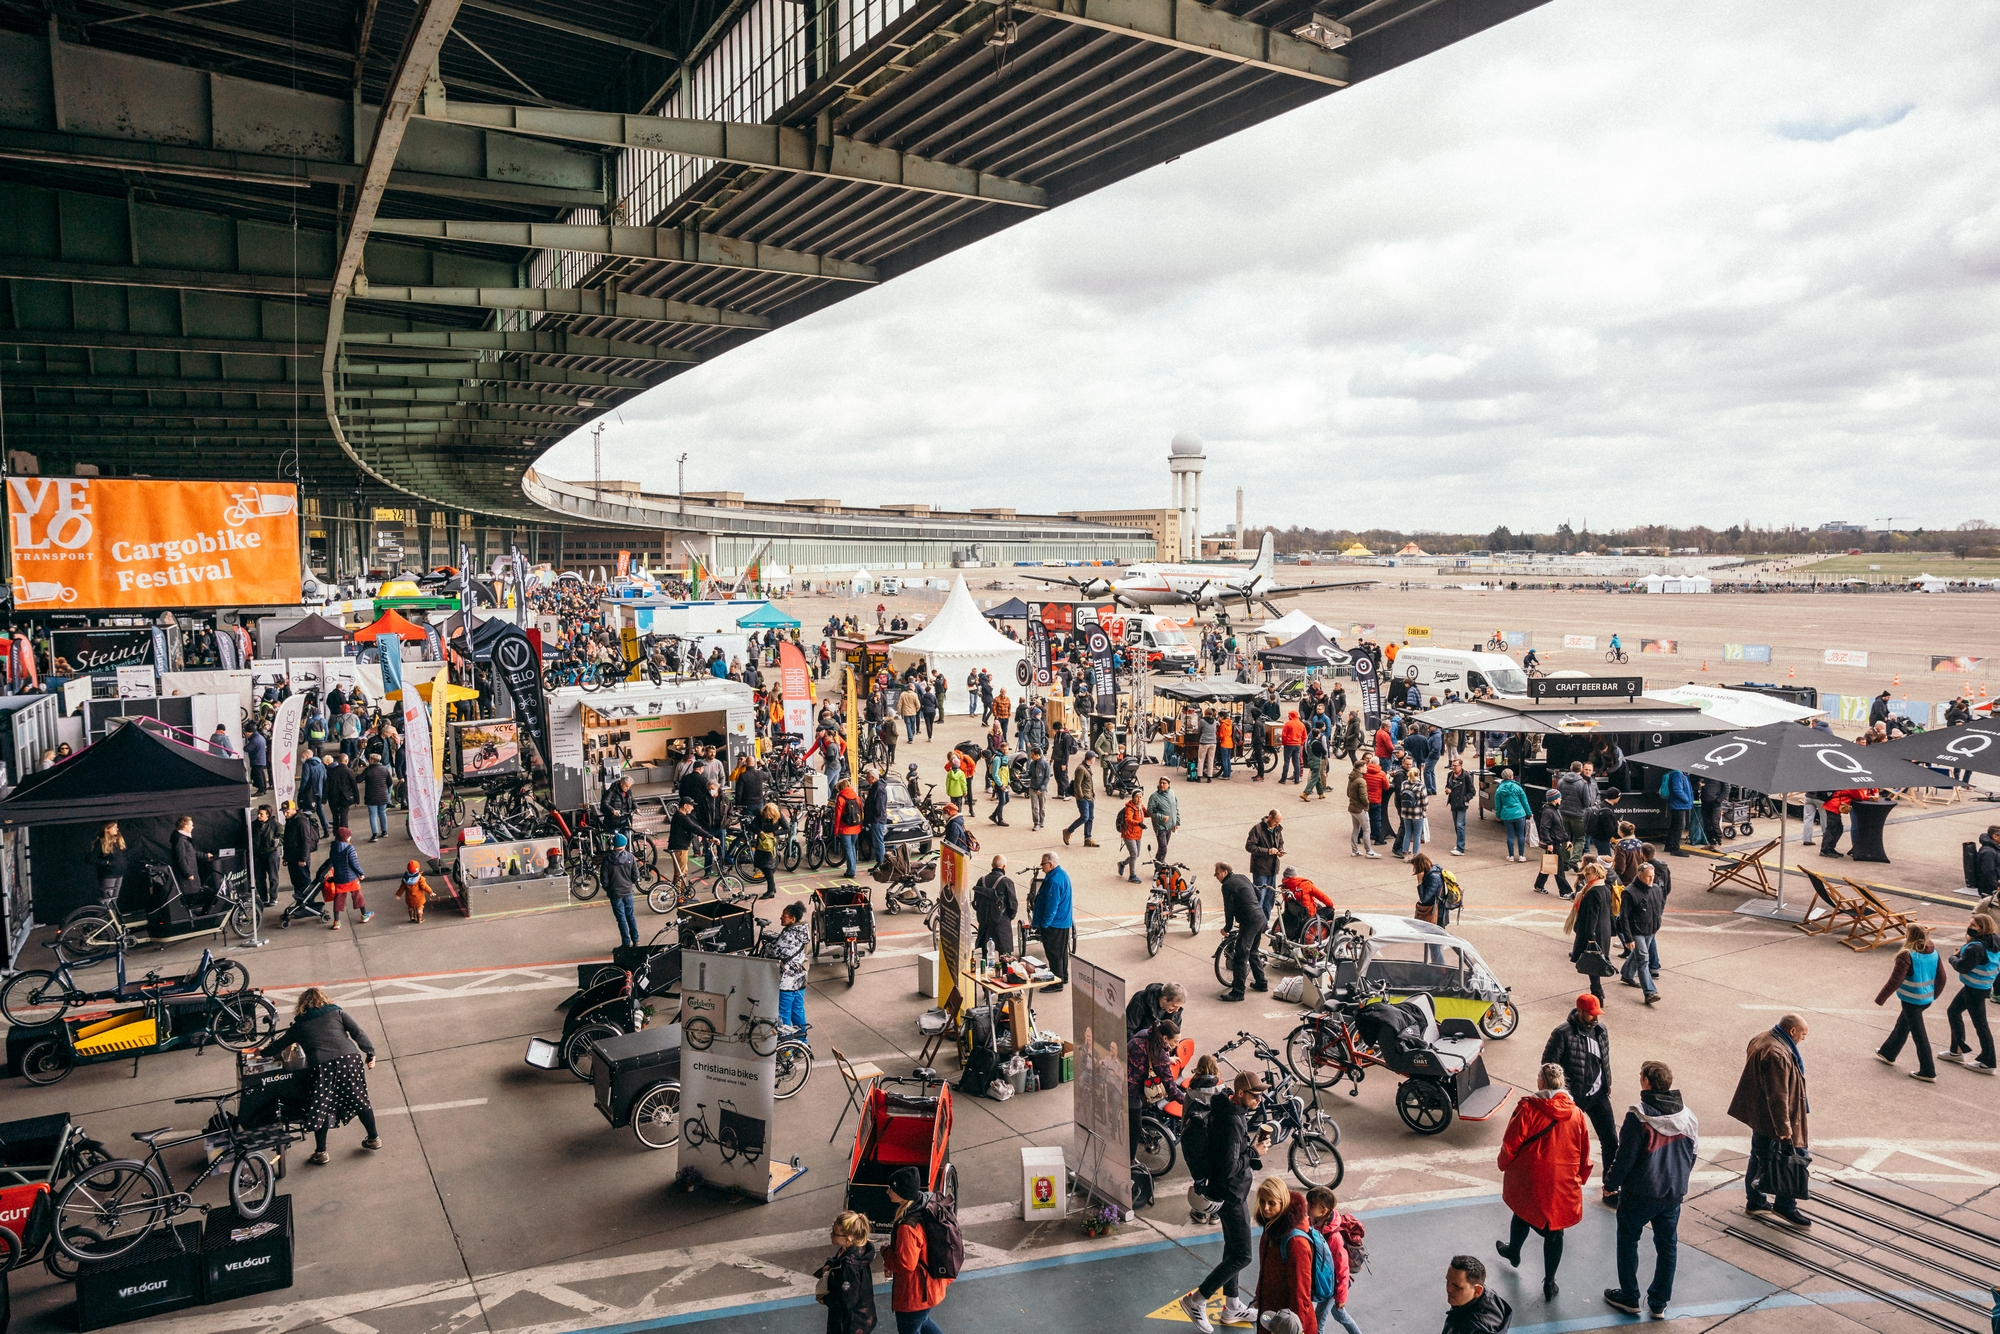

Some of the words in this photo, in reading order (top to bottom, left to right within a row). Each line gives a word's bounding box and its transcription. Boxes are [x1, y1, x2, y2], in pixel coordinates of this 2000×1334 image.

[15, 552, 93, 561] TRANSPORT
[112, 529, 261, 563] Cargobike
[116, 558, 233, 592] Festival
[73, 639, 151, 671] Steinig
[381, 639, 391, 684] winther
[506, 670, 535, 685] VELLO
[1556, 683, 1581, 691] CRAFT
[1582, 683, 1601, 691] BEER
[1602, 682, 1618, 691] BAR
[284, 709, 295, 748] sblocs
[636, 719, 671, 730] BONJOUR
[1704, 743, 1748, 766] Q
[1946, 734, 1992, 758] Q
[1816, 749, 1872, 775] Q
[687, 996, 715, 1010] Carlsberg
[693, 1062, 736, 1077] christiania
[737, 1069, 758, 1081] bikes
